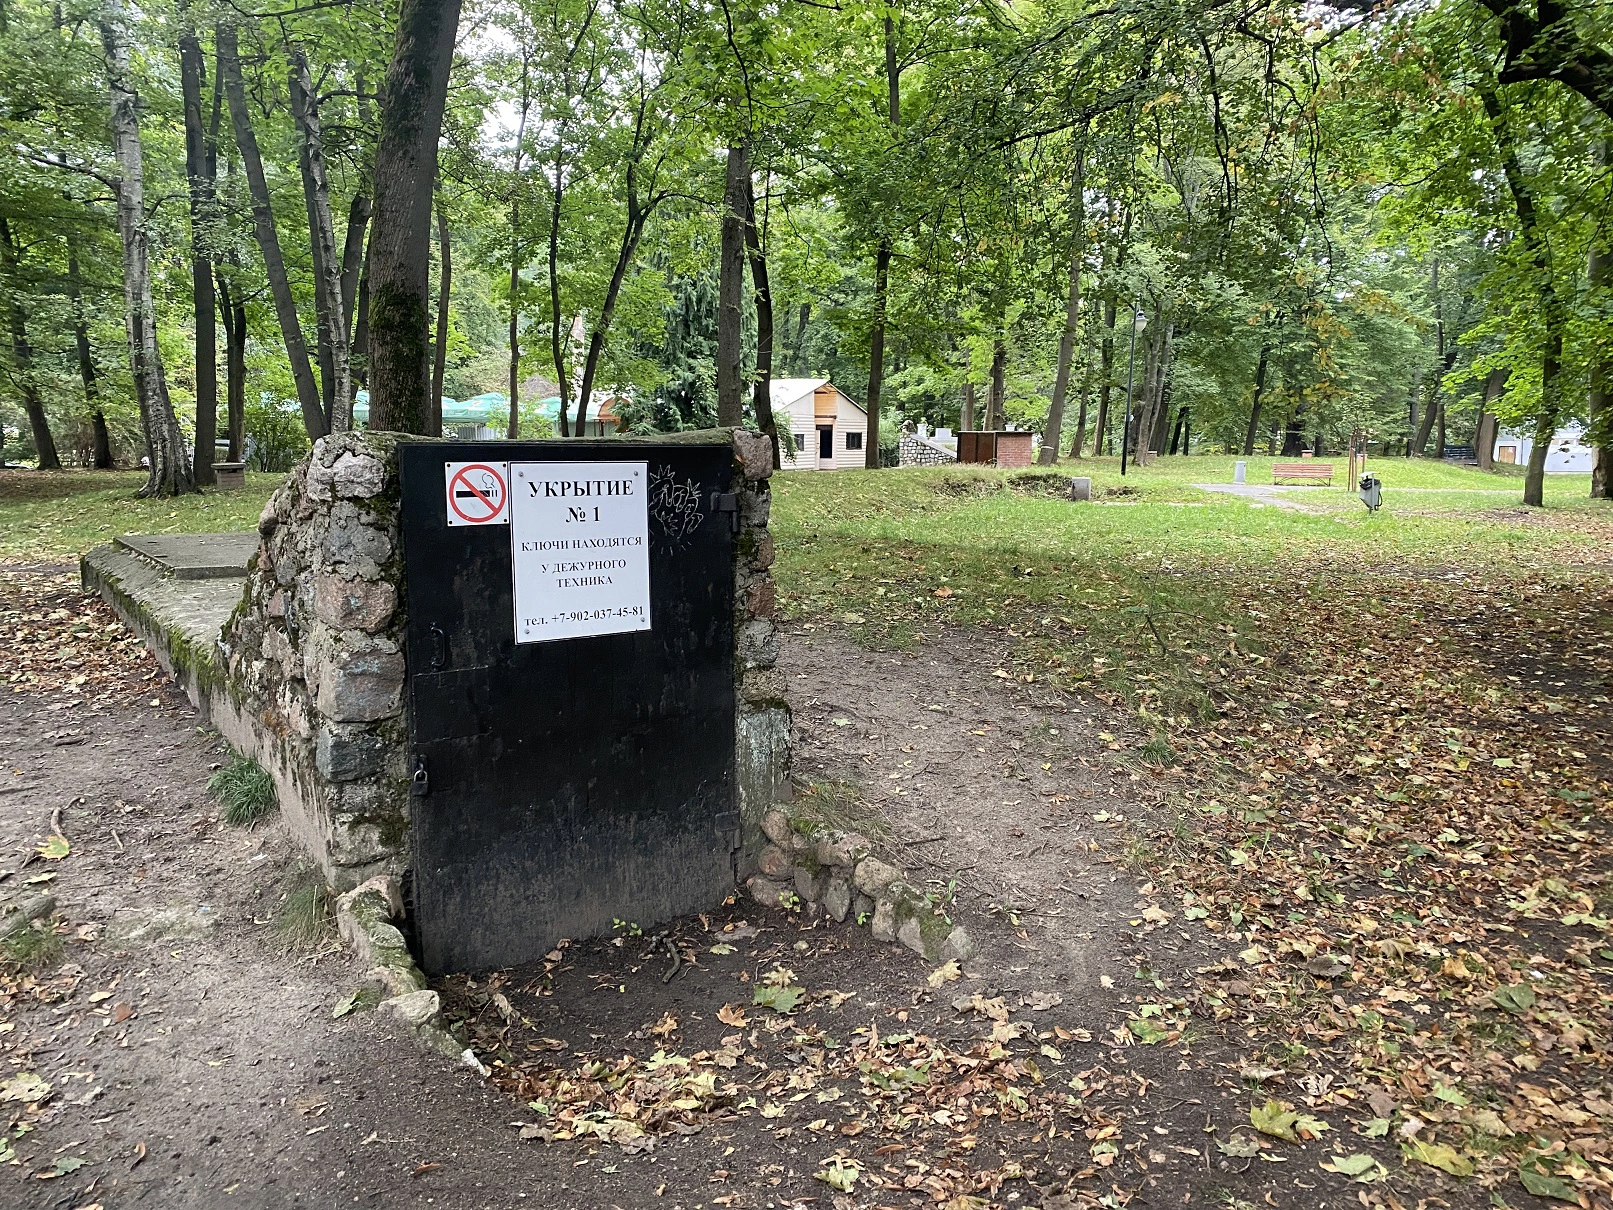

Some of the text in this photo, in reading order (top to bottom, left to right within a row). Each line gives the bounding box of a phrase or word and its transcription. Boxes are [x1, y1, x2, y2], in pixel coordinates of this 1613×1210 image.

[528, 479, 634, 498] УКРЫТИЕ
[565, 506, 600, 523] № 1
[521, 536, 642, 552] КЛЮЧИ НАХОДЯТСЯ
[541, 559, 626, 574] У ДЕЖУРНОГО
[556, 576, 613, 588] ТЕХНИКА
[524, 606, 644, 627] тел. +7-902-037-45-81
